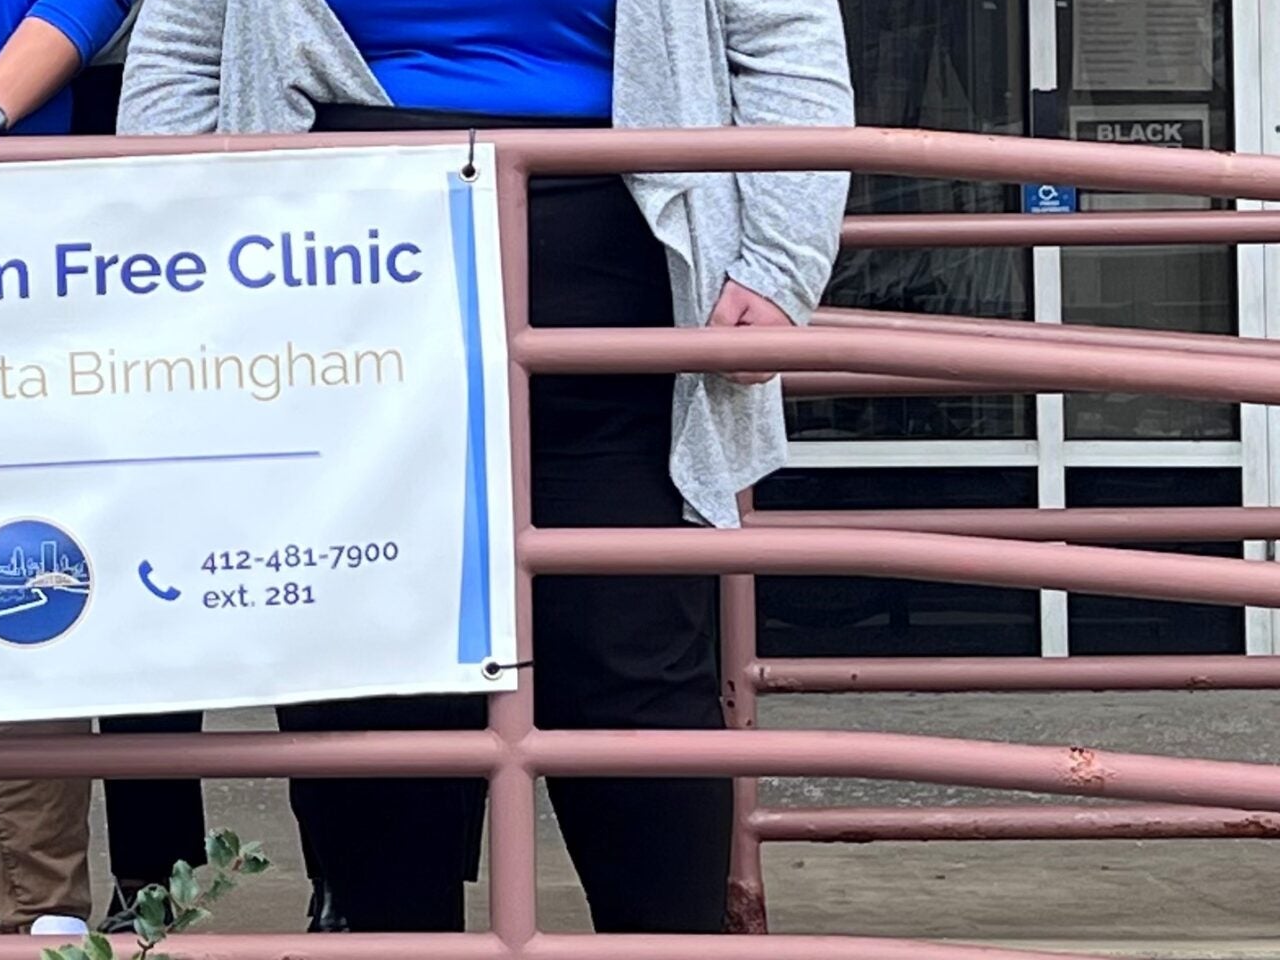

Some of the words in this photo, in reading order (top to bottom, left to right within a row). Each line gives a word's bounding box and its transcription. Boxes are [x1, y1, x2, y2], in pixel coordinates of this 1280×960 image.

[1097, 122, 1182, 142] BLACK
[55, 242, 207, 297] Free
[228, 228, 423, 289] Clinic
[69, 341, 404, 401] Birmingham
[200, 541, 399, 575] 412-481-7900
[202, 584, 256, 609] ext.
[265, 582, 316, 606] 281
